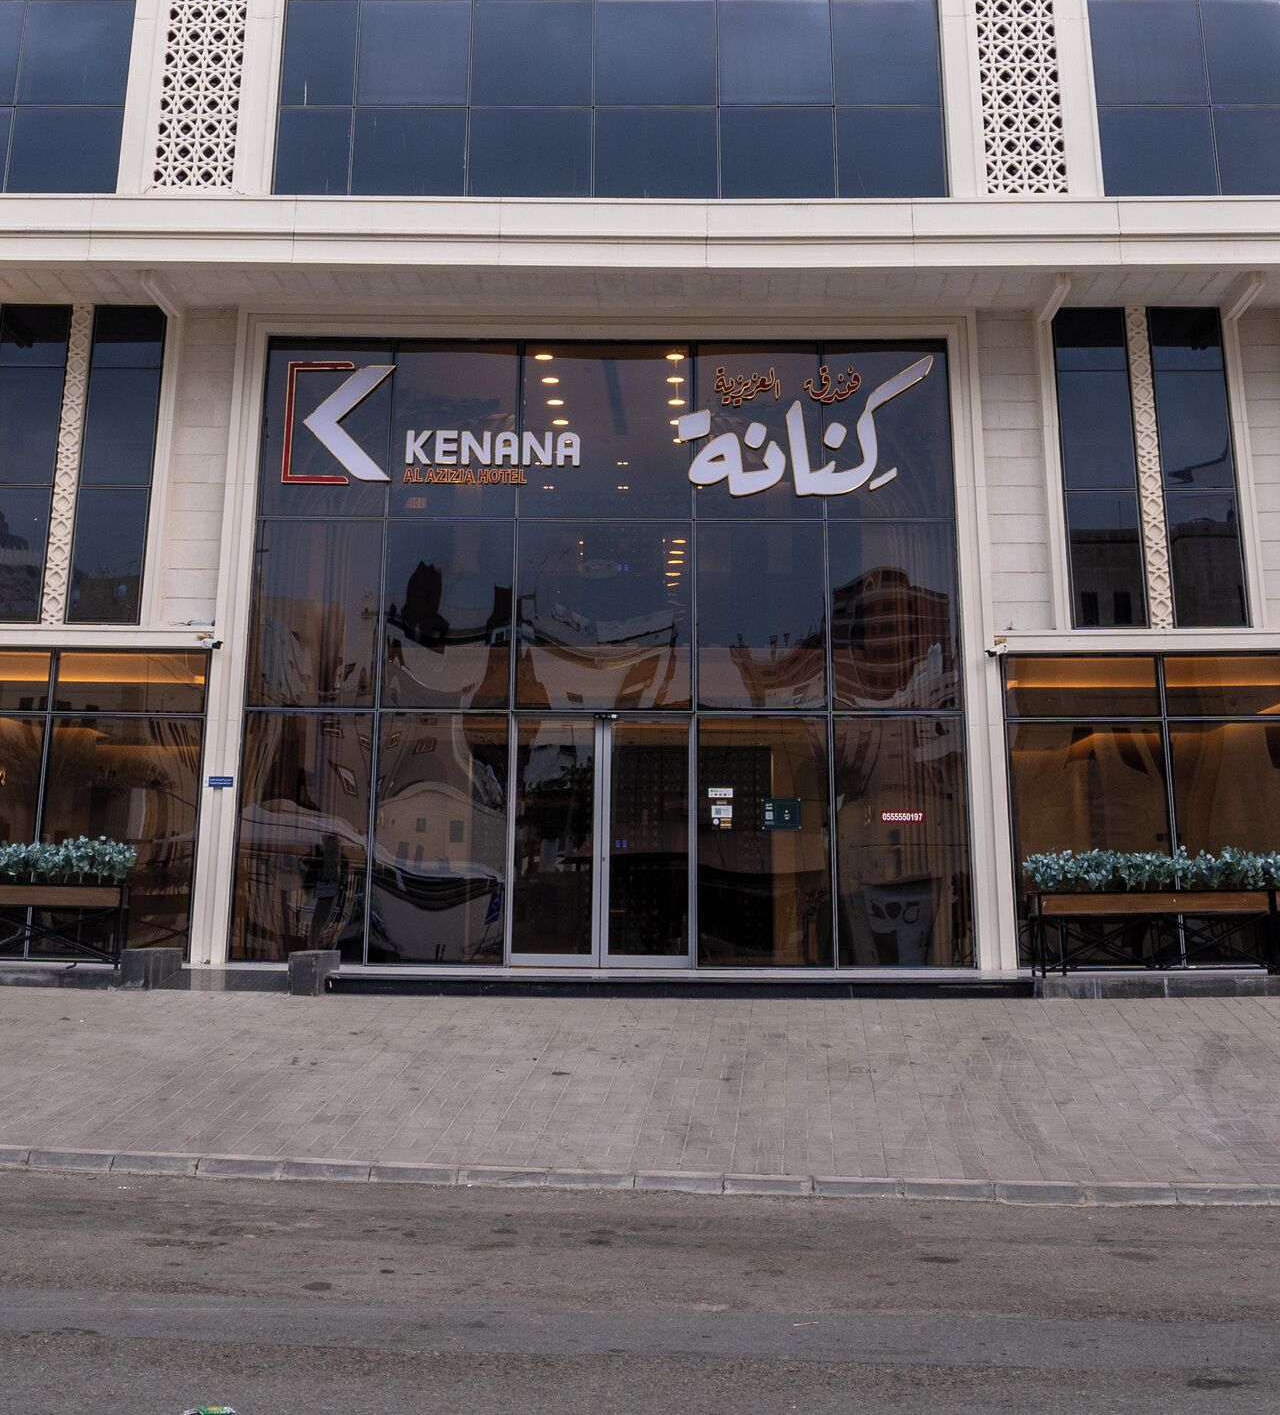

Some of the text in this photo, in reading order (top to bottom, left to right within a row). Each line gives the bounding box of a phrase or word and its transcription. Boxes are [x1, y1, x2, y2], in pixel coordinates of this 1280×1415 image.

[714, 365, 862, 407] فندق العزيزية
[405, 430, 581, 467] KENANA
[403, 468, 528, 485] AL AZIZIA HOTEL
[882, 812, 923, 821] 0555550197
